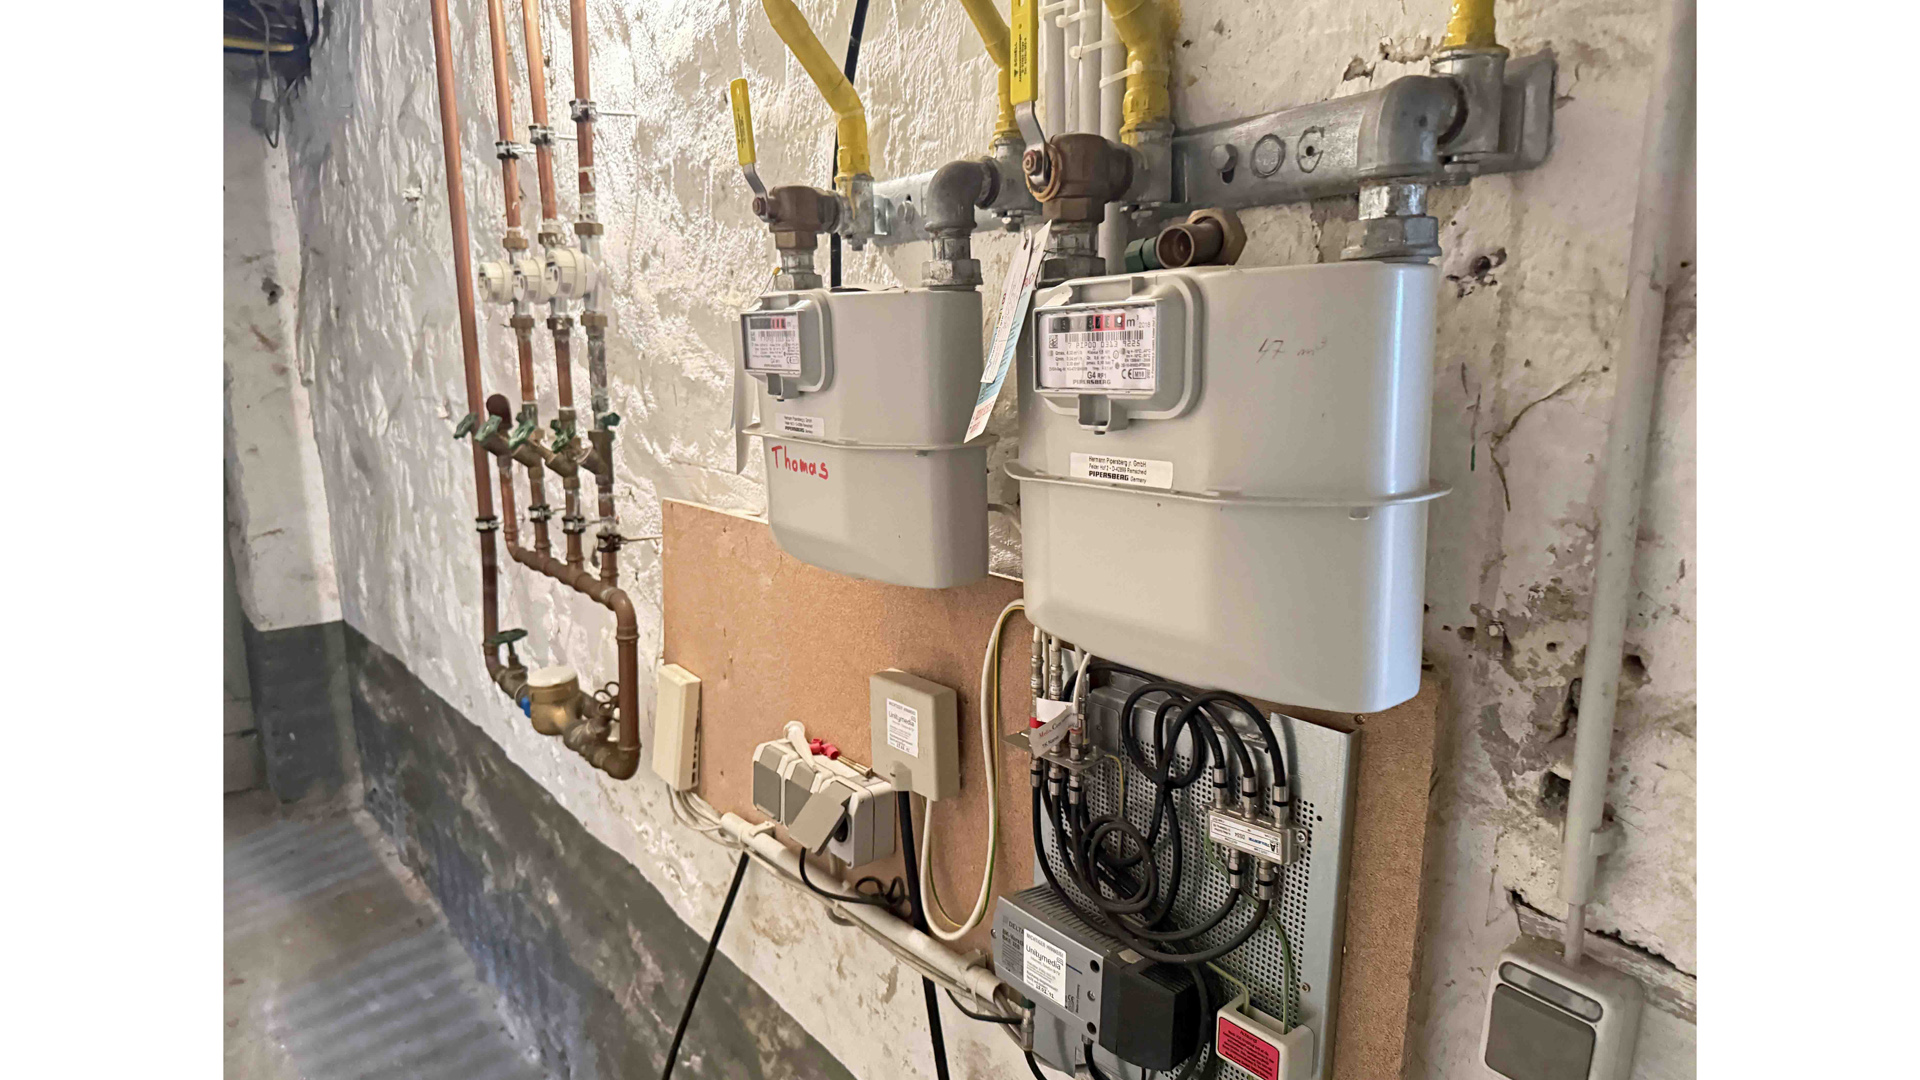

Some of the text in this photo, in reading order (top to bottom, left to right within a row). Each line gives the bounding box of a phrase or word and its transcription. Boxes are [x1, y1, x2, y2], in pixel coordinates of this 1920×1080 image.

[1122, 340, 1141, 348] 9225
[1087, 371, 1096, 379] G4
[771, 445, 829, 480] Thomas
[1133, 460, 1147, 468] GmbH
[1088, 470, 1147, 484] PIPERSBERG Germany
[1025, 944, 1061, 971] Unitymedia
